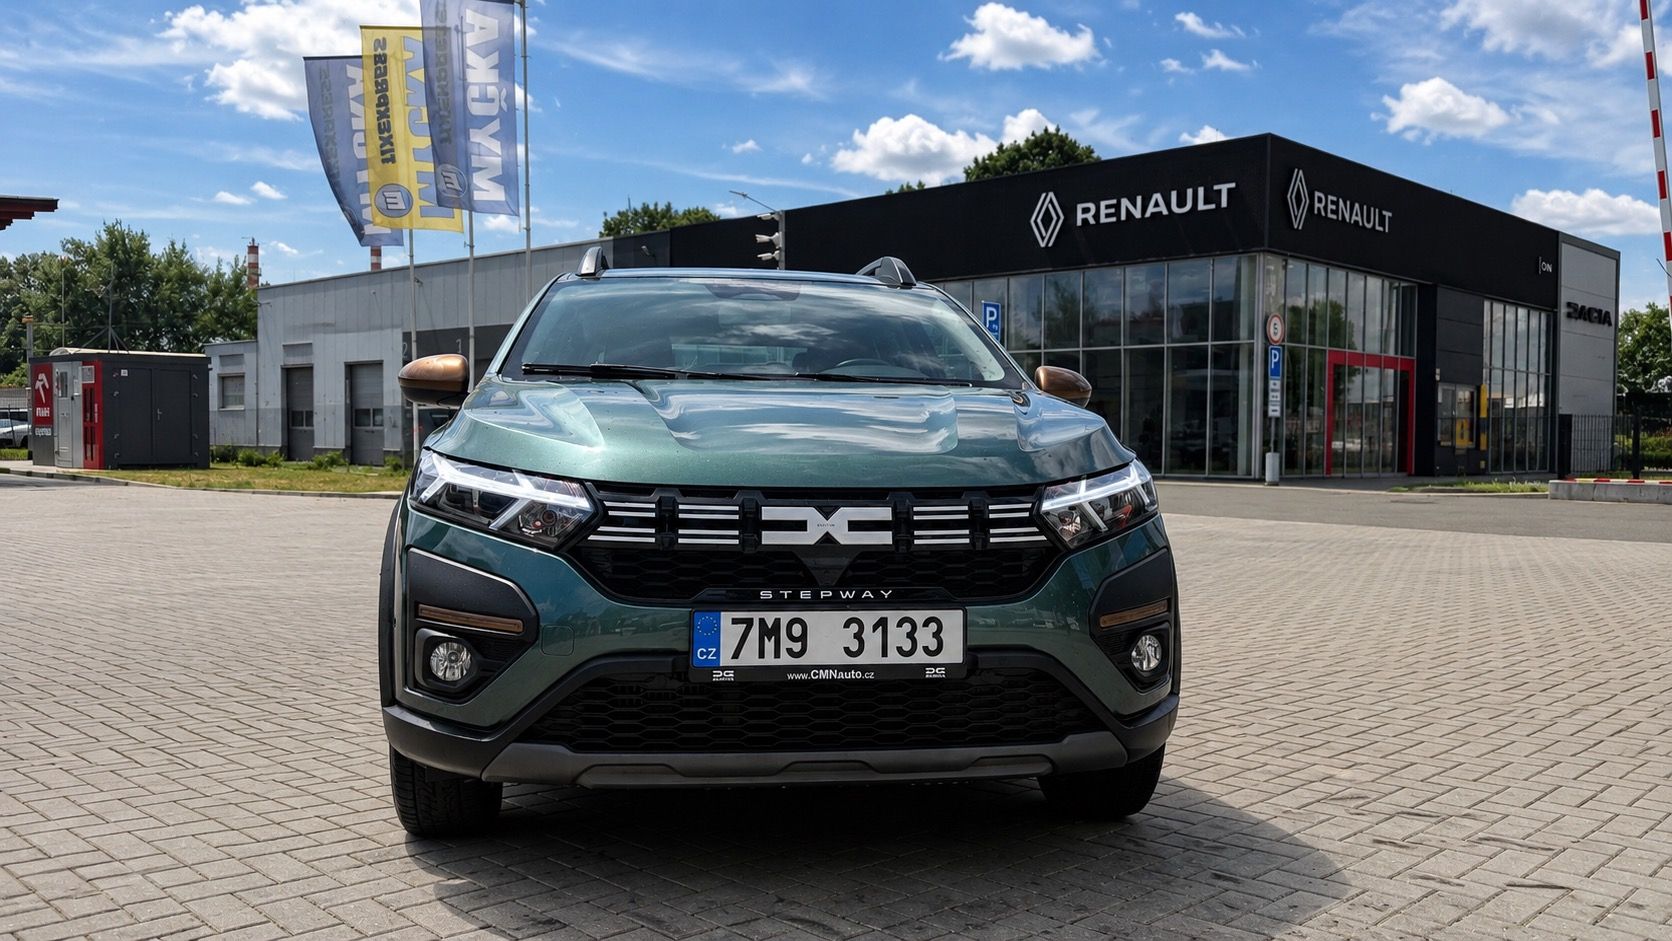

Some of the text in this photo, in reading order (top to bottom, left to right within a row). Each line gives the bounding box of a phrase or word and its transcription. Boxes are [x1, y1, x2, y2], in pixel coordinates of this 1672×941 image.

[1076, 182, 1237, 227] RENAULT
[1314, 190, 1393, 233] RENAULT
[986, 307, 997, 328] P
[1271, 350, 1280, 369] P
[760, 590, 893, 599] STEPWAY
[730, 615, 945, 660] 7M9 3133
[697, 648, 717, 660] CZ
[787, 669, 875, 681] www.CMNauto.cz
